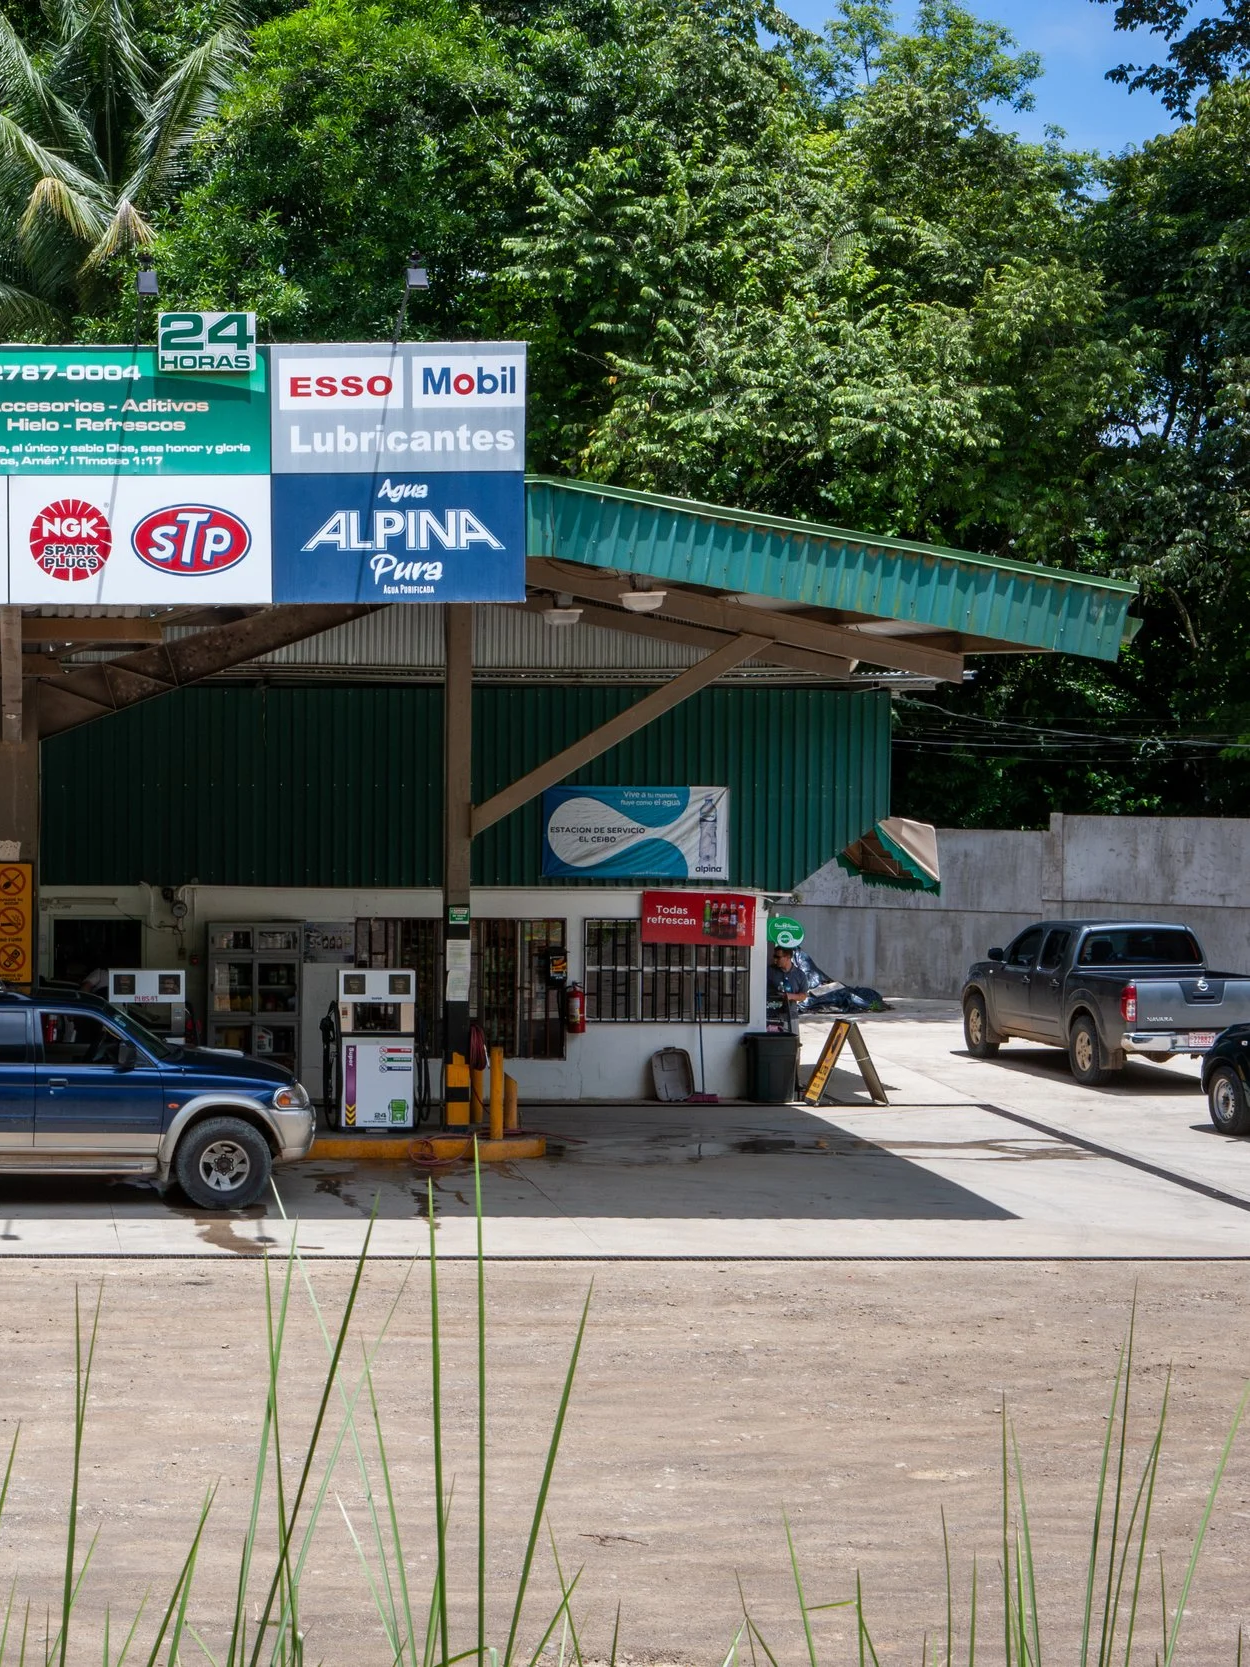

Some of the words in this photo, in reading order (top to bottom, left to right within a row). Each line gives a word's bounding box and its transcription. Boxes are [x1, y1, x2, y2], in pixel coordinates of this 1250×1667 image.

[160, 313, 254, 351] 24
[160, 354, 251, 370] HORAS
[289, 375, 393, 398] ESSO
[422, 366, 516, 395] Mobil
[121, 399, 209, 413] Aditivos
[7, 418, 60, 432] Hielo
[76, 418, 186, 432] Refrescos
[290, 423, 516, 453] Lubricantes
[12, 443, 23, 453] al
[25, 442, 59, 453] único
[61, 445, 68, 455] y
[70, 443, 104, 453] sabio
[106, 443, 139, 454] Dios,
[141, 445, 163, 453] sea
[166, 443, 203, 453] honor
[206, 445, 214, 455] y
[215, 443, 251, 455] gloria
[77, 456, 130, 465] Timoteo
[132, 456, 163, 465] 1:17
[377, 478, 429, 503] Agua
[42, 517, 99, 539] NGK
[300, 508, 507, 552] ALPINA
[148, 512, 233, 567] STP
[44, 545, 98, 556] SPARK
[44, 557, 98, 569] PLUGS
[369, 553, 444, 585] Pura
[623, 790, 640, 798] Vive
[654, 798, 661, 806] el
[550, 826, 591, 834] ESTACION
[695, 864, 723, 874] alpina
[656, 905, 688, 914] Todas
[646, 916, 696, 926] refrescan
[347, 1047, 355, 1067] Super
